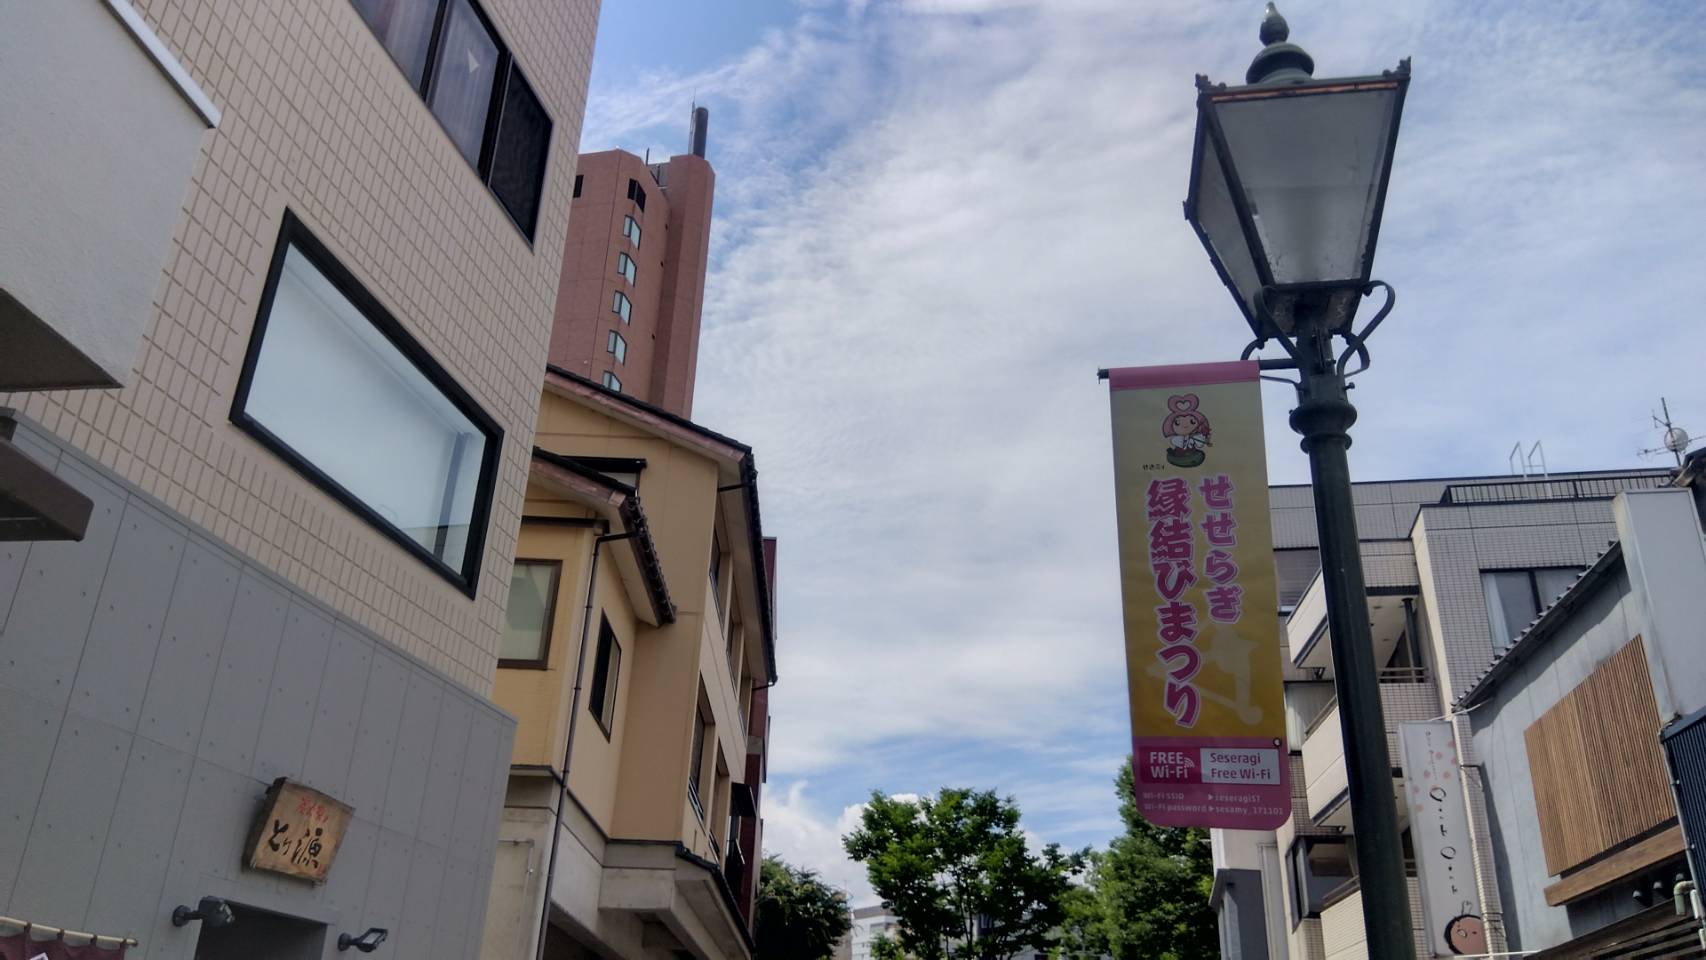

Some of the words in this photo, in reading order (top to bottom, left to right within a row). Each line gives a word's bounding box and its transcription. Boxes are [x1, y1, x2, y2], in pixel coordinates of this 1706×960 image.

[1199, 474, 1242, 623] せせらぎ
[1147, 477, 1201, 728] 縁結びまつり
[1150, 752, 1184, 765] FREE
[1210, 752, 1261, 766] Seseragi
[1151, 766, 1188, 779] Wi-Fi
[1211, 768, 1237, 779] Free
[1240, 768, 1271, 780] Wi-Fi
